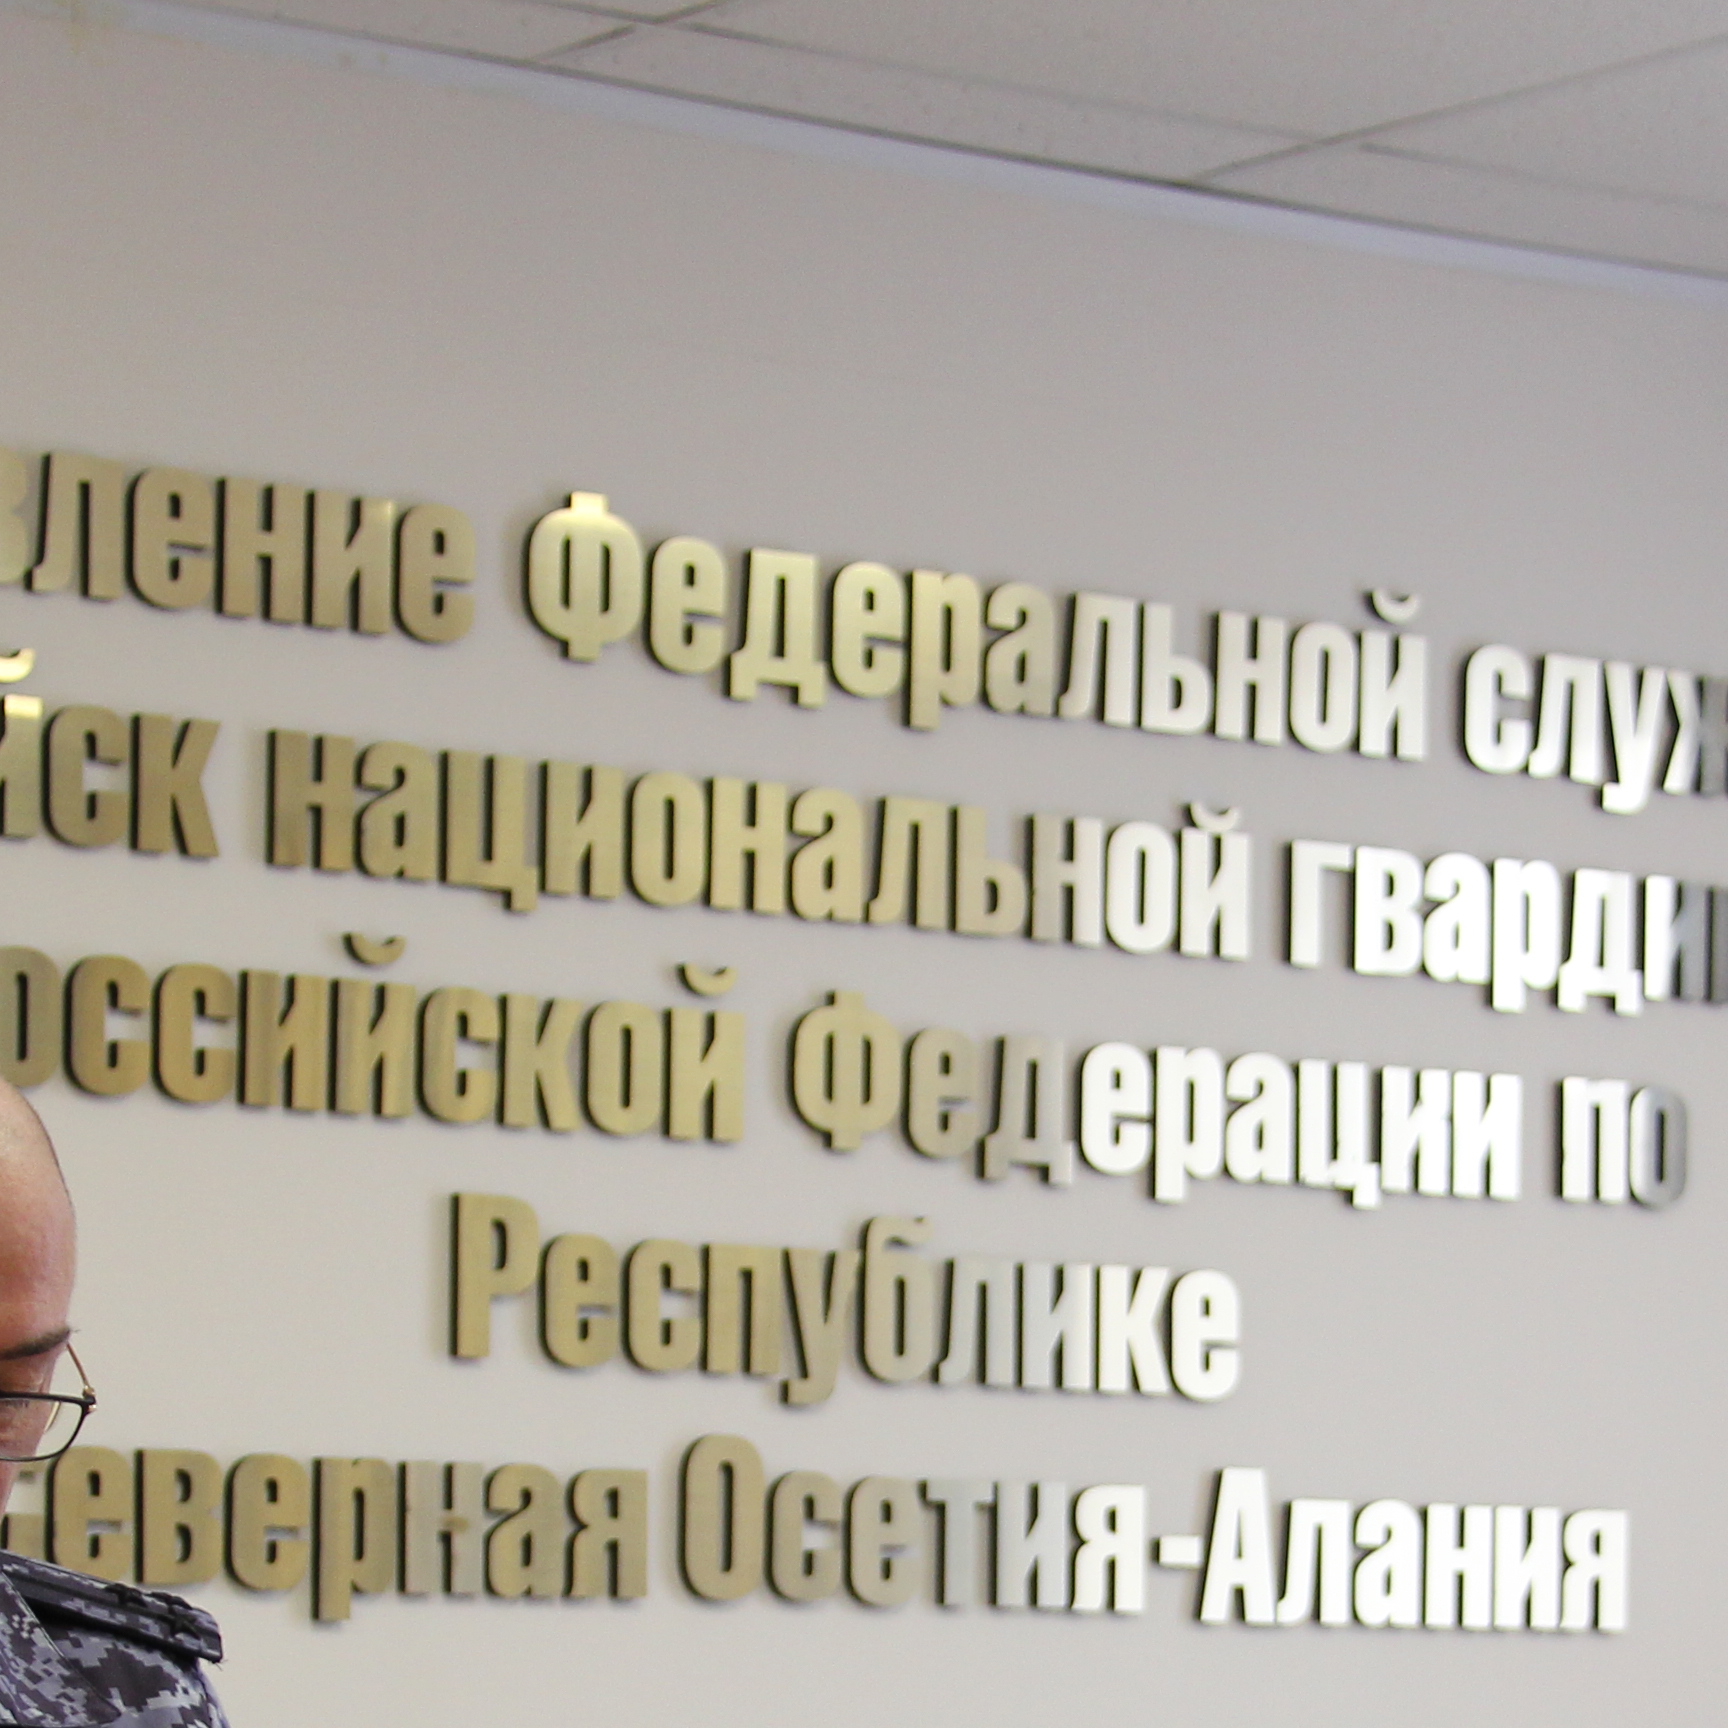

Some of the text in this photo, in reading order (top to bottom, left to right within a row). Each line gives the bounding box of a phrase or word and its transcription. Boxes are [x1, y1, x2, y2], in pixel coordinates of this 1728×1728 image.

[526, 490, 1429, 761] Федеральной
[265, 727, 1251, 962] национальной
[790, 988, 1522, 1209] Федерации
[1559, 1076, 1689, 1210] по
[450, 1192, 1240, 1406] Республике
[679, 1432, 1628, 1634] Осетия-Алания
